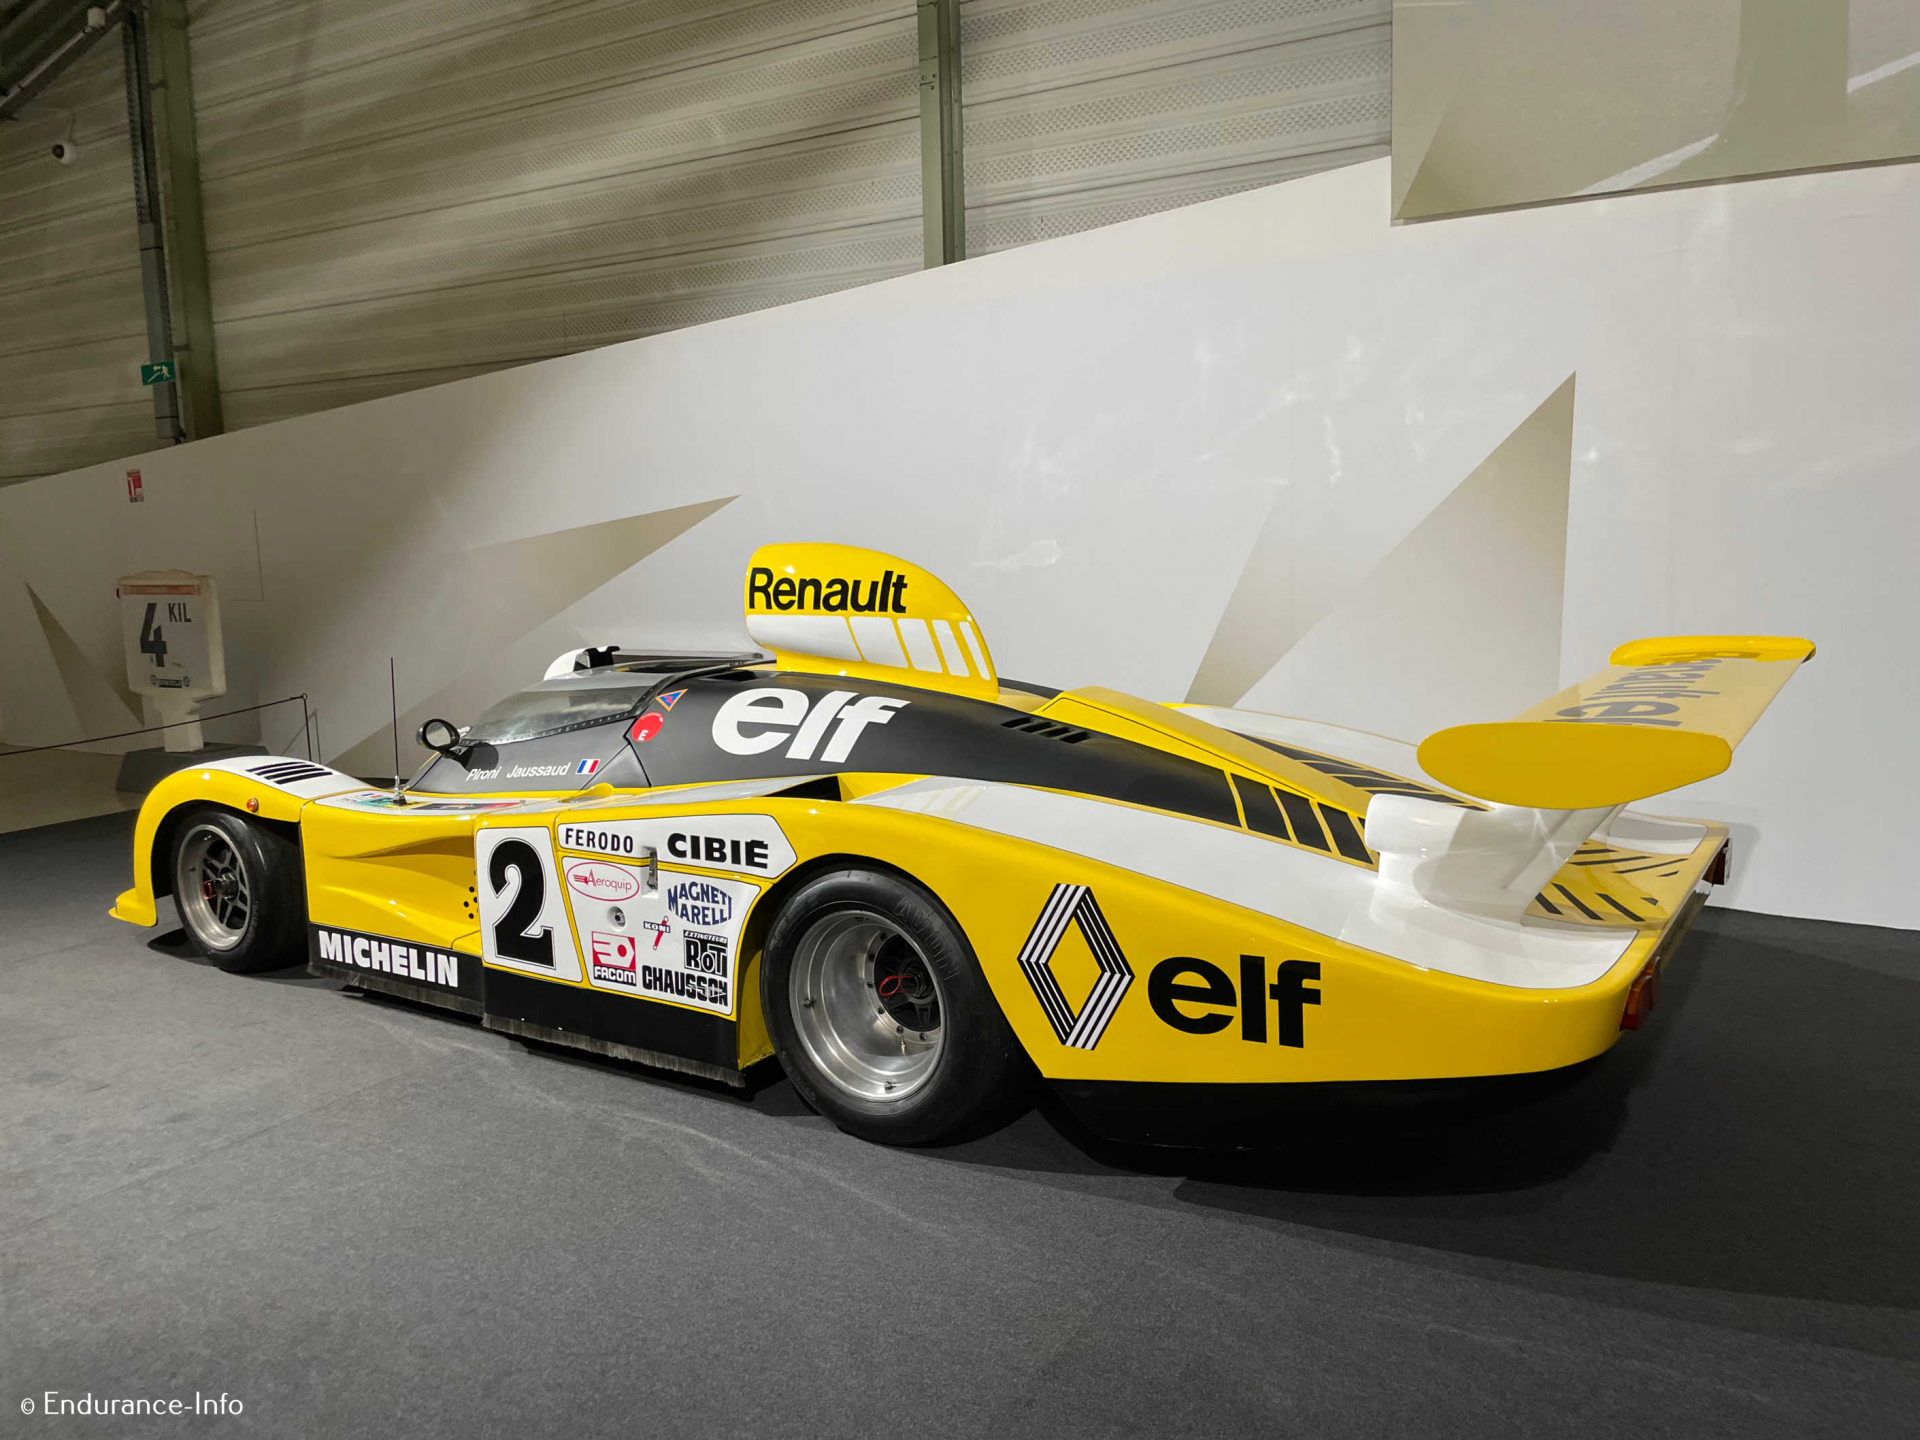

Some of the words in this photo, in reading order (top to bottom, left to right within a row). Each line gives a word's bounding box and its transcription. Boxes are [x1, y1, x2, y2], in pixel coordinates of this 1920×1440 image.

[749, 567, 908, 614] Renault
[140, 602, 167, 667] 4
[168, 603, 192, 622] KIL
[712, 687, 912, 763] elf
[465, 766, 502, 781] Pironi
[506, 762, 571, 779] Jaussaud
[565, 827, 634, 853] FERODO
[573, 869, 632, 893] Aeroquip
[667, 881, 732, 908] MAGNETI
[489, 838, 555, 970] 2
[668, 901, 732, 926] MARELLI
[644, 922, 670, 933] KONI
[893, 896, 960, 982] AVON
[318, 930, 458, 987] MICHELIN
[594, 966, 637, 985] FACOM
[642, 965, 728, 1007] CHAUSSON
[1147, 954, 1321, 1048] elf
